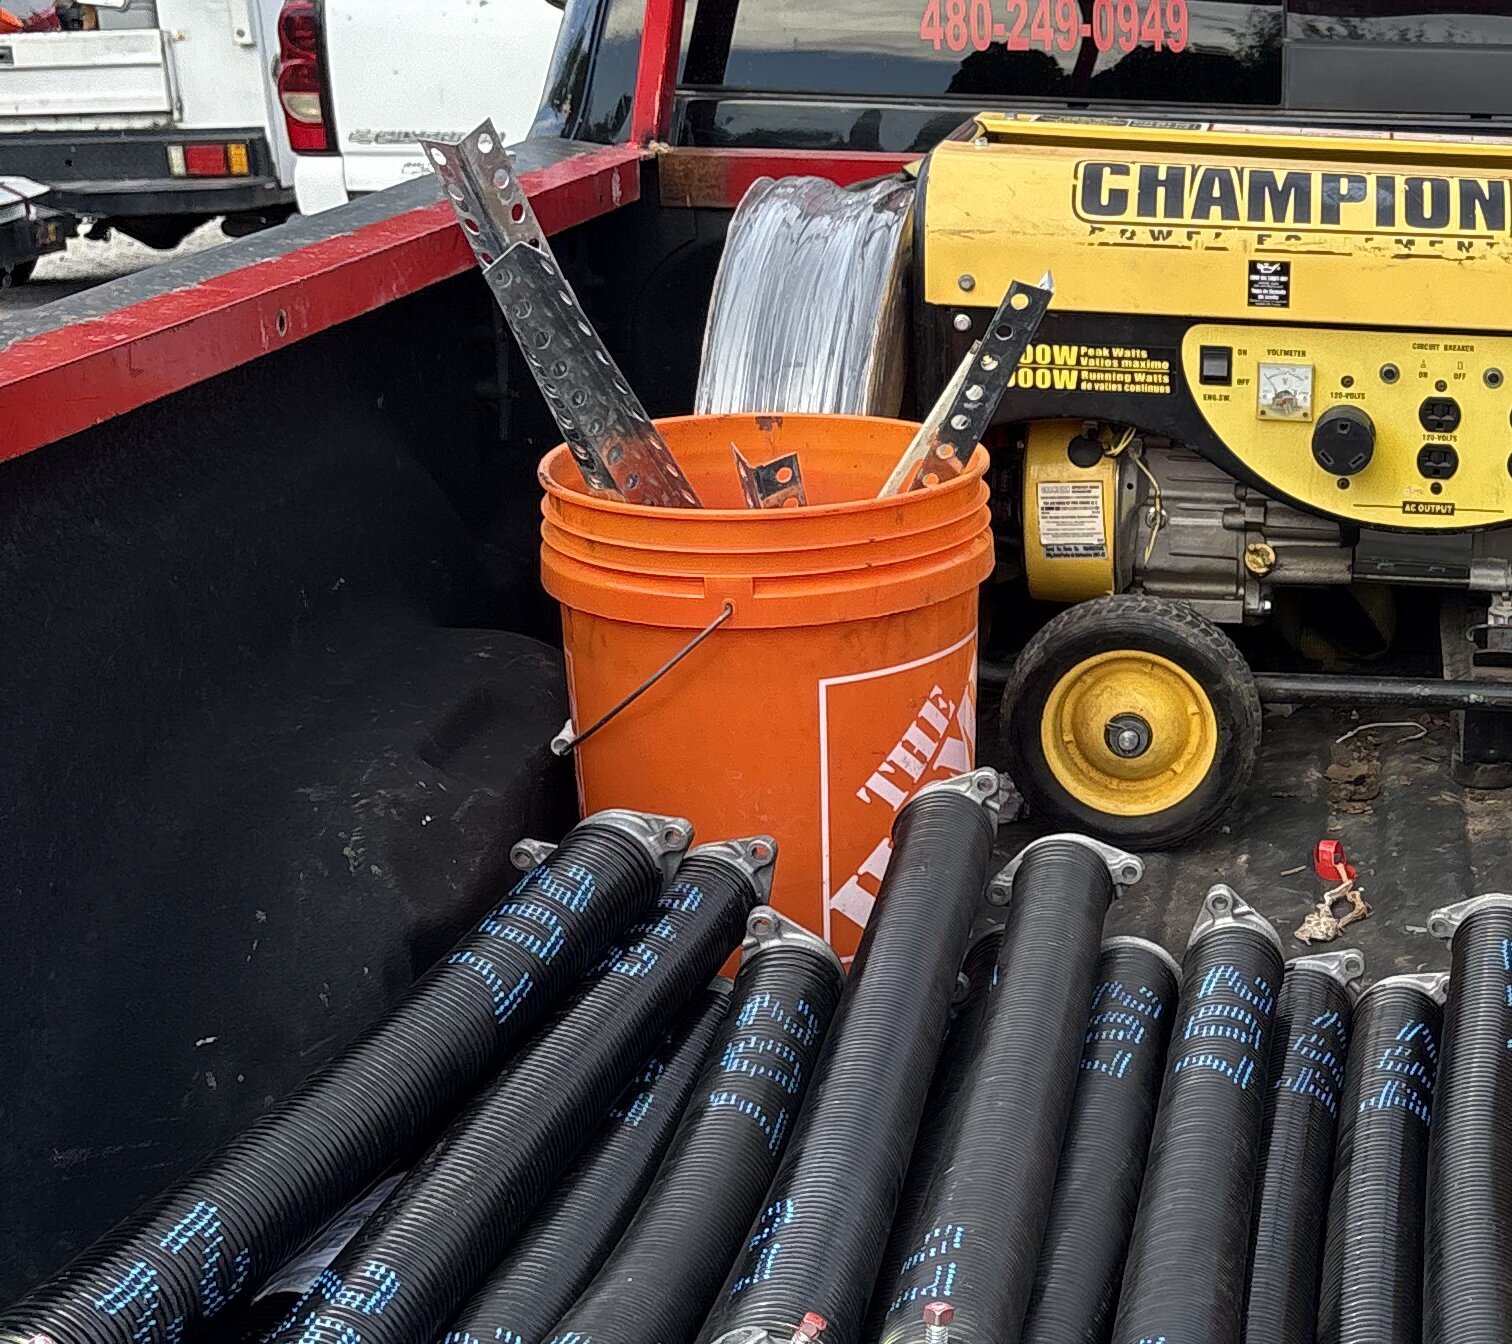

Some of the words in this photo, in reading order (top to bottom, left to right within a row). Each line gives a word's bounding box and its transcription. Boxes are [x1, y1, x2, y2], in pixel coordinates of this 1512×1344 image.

[1082, 162, 1506, 231] CHAMPION
[1081, 346, 1110, 357] Peak
[1112, 348, 1148, 358] Watts
[1412, 343, 1440, 351] CIRCUIT
[1444, 344, 1475, 352] BREAKER
[1267, 349, 1306, 357] VOLTMETER
[1081, 371, 1132, 383] Running
[1134, 373, 1169, 383] Watts
[1453, 372, 1466, 380] OFF
[1081, 381, 1092, 390] de
[1330, 392, 1366, 400] 120-VOLTS
[1422, 434, 1457, 442] 120-VOLTS
[1404, 504, 1416, 512] AC
[1418, 504, 1453, 514] OUTPUT
[856, 685, 955, 812] THE
